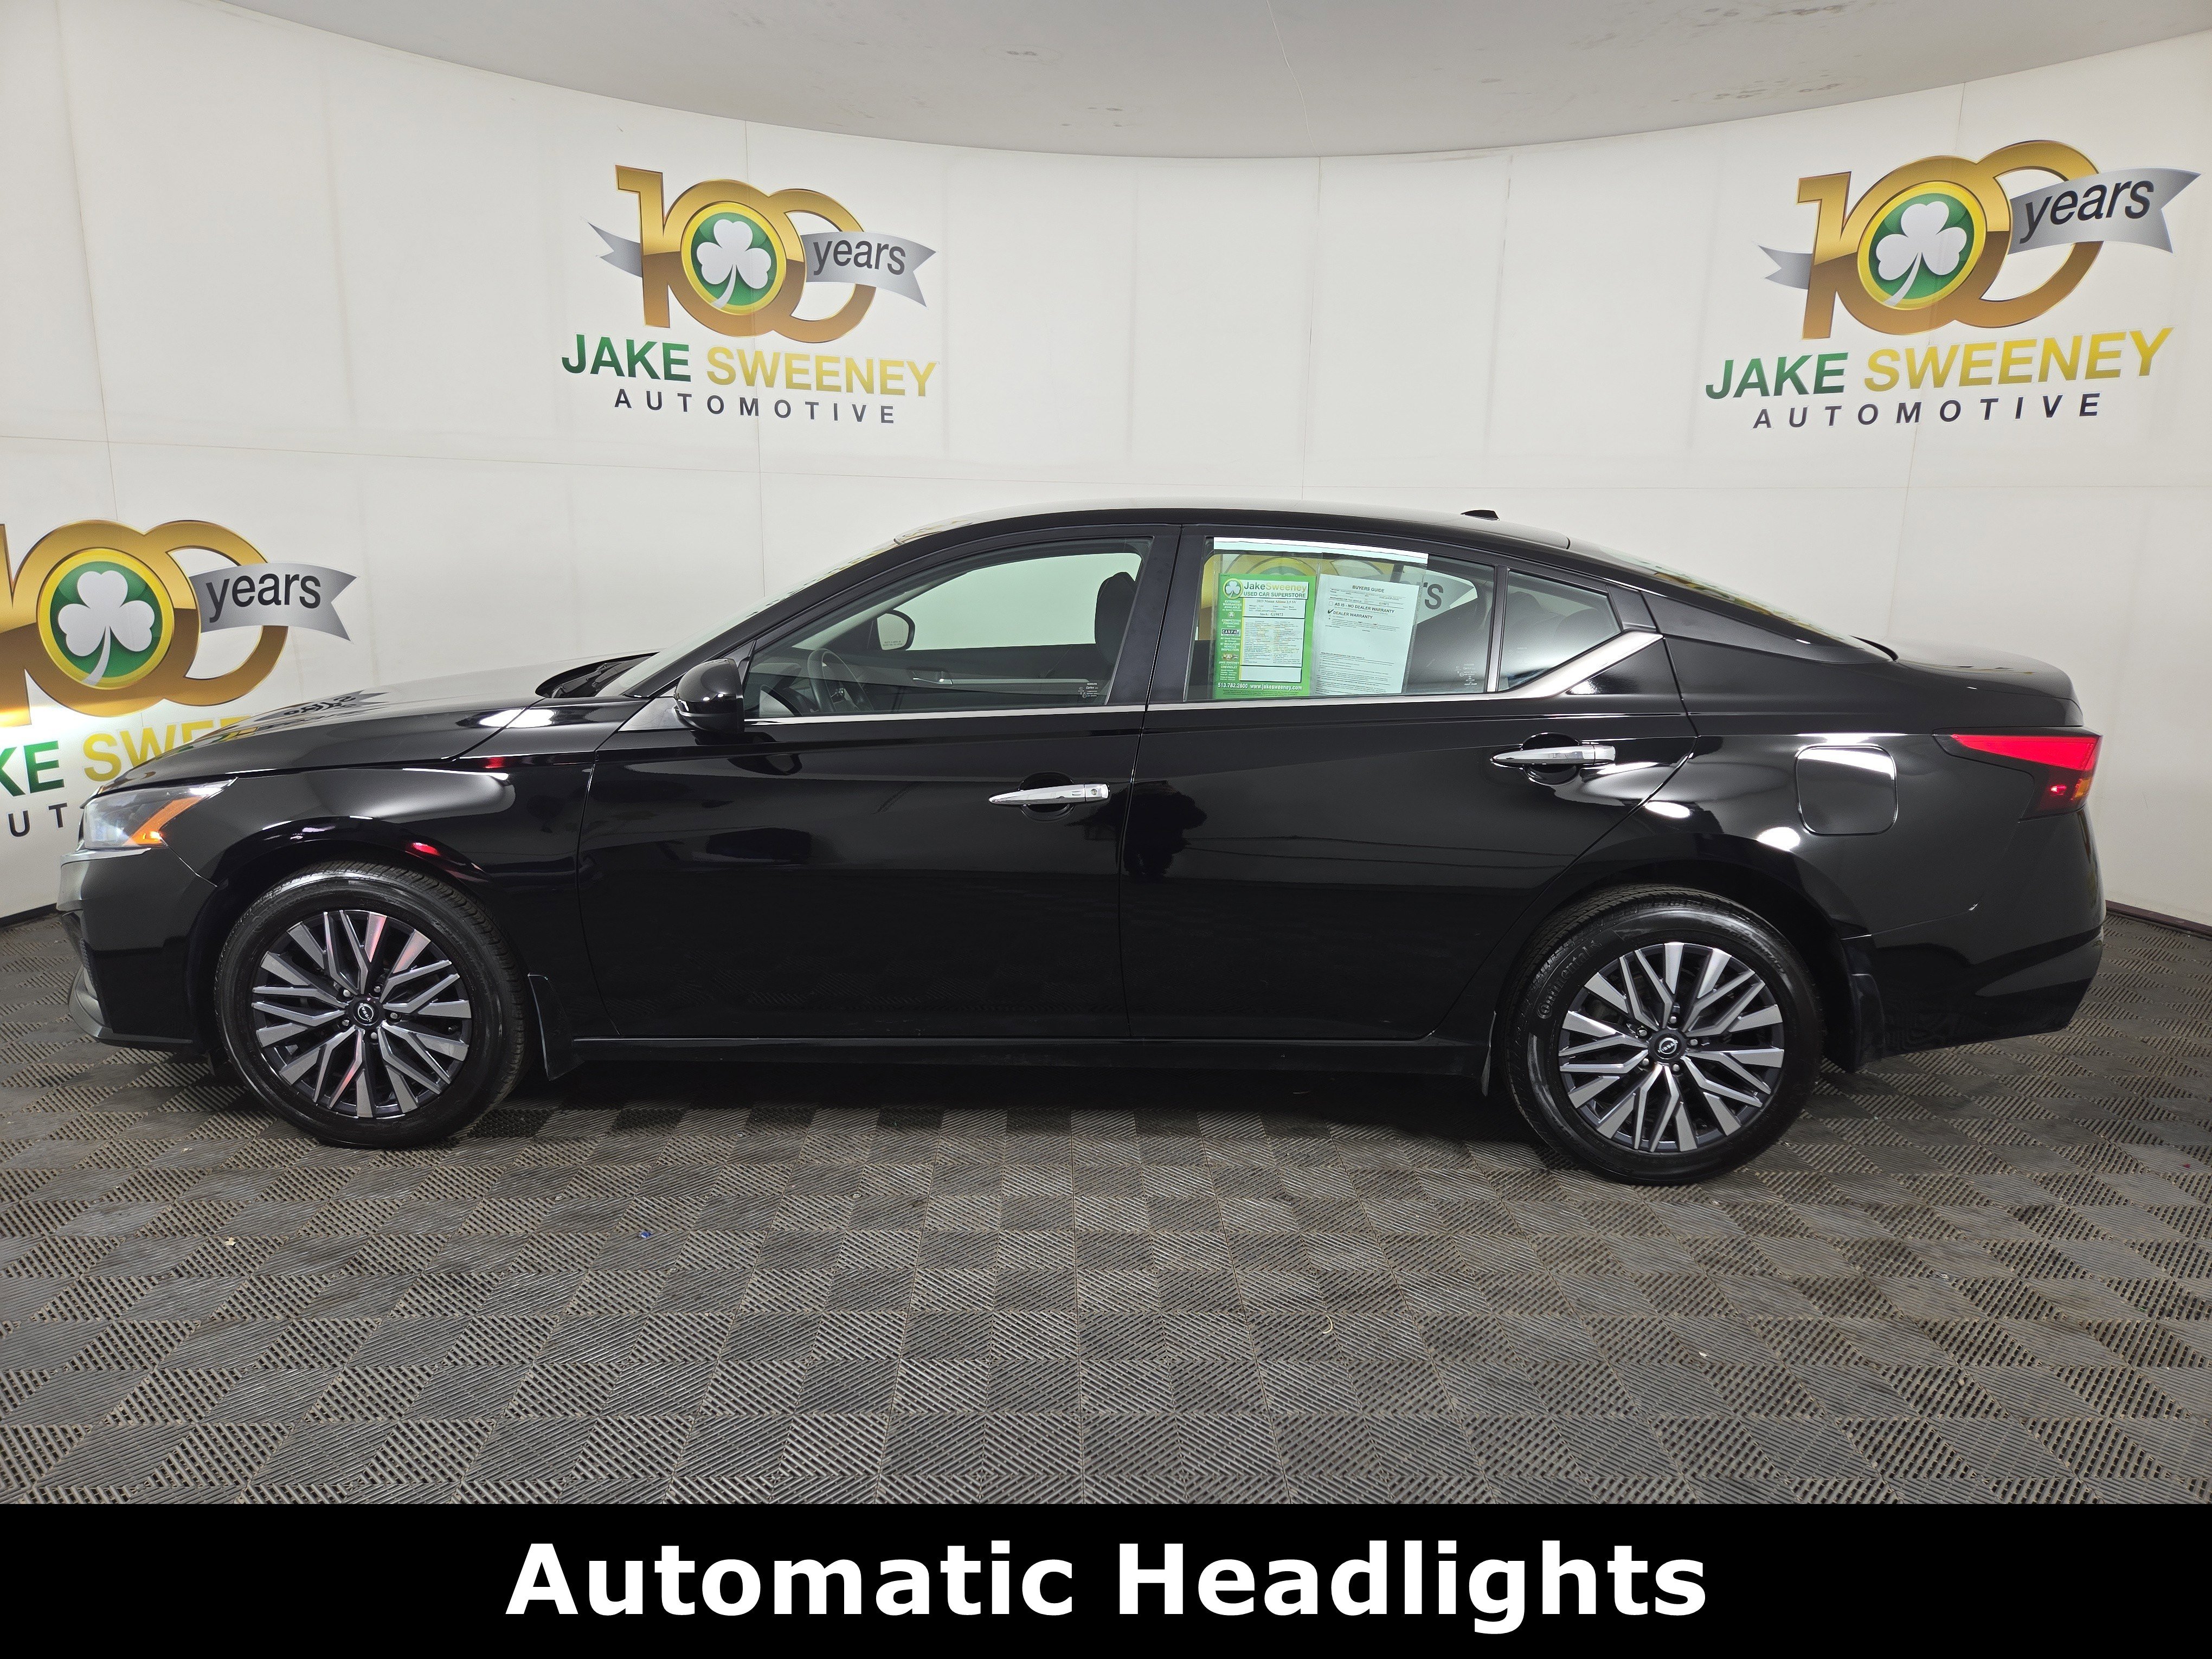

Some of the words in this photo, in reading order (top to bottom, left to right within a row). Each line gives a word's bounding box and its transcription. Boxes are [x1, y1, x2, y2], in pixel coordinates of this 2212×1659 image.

[1797, 139, 2104, 340] 100
[2020, 179, 2154, 244] years
[615, 164, 876, 344] 100
[813, 239, 906, 275] years
[562, 333, 692, 382] JAKE
[706, 346, 937, 397] SWEENEY
[1706, 352, 1849, 399] JAKE
[1864, 327, 2174, 393] SWEENEY
[614, 389, 895, 423] AUTOMOTIVE
[1753, 392, 2101, 429] AUTOMOTIVE
[205, 573, 321, 623] years
